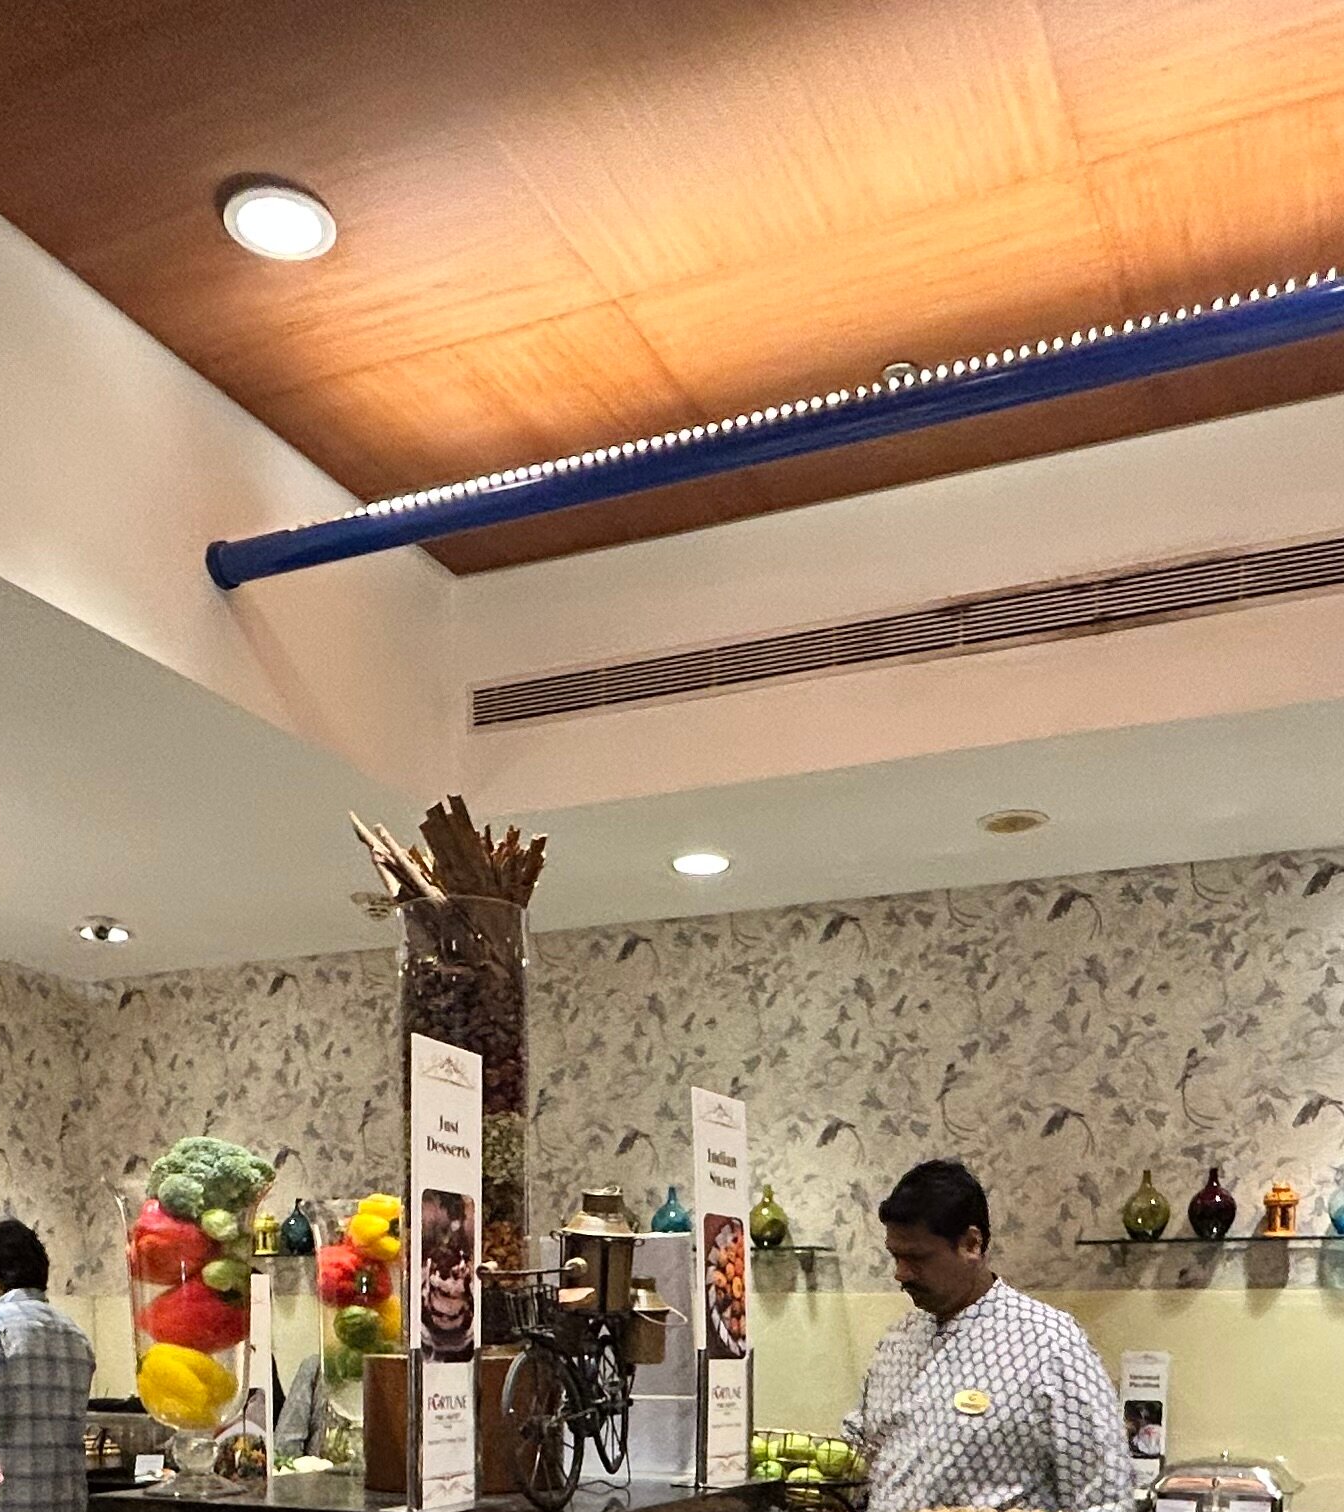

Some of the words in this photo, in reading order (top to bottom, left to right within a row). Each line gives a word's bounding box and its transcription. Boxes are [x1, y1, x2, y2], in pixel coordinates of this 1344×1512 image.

[439, 1114, 459, 1134] Just
[426, 1136, 471, 1159] Desserts
[707, 1148, 737, 1168] Indian
[428, 1393, 467, 1410] FORTUNE
